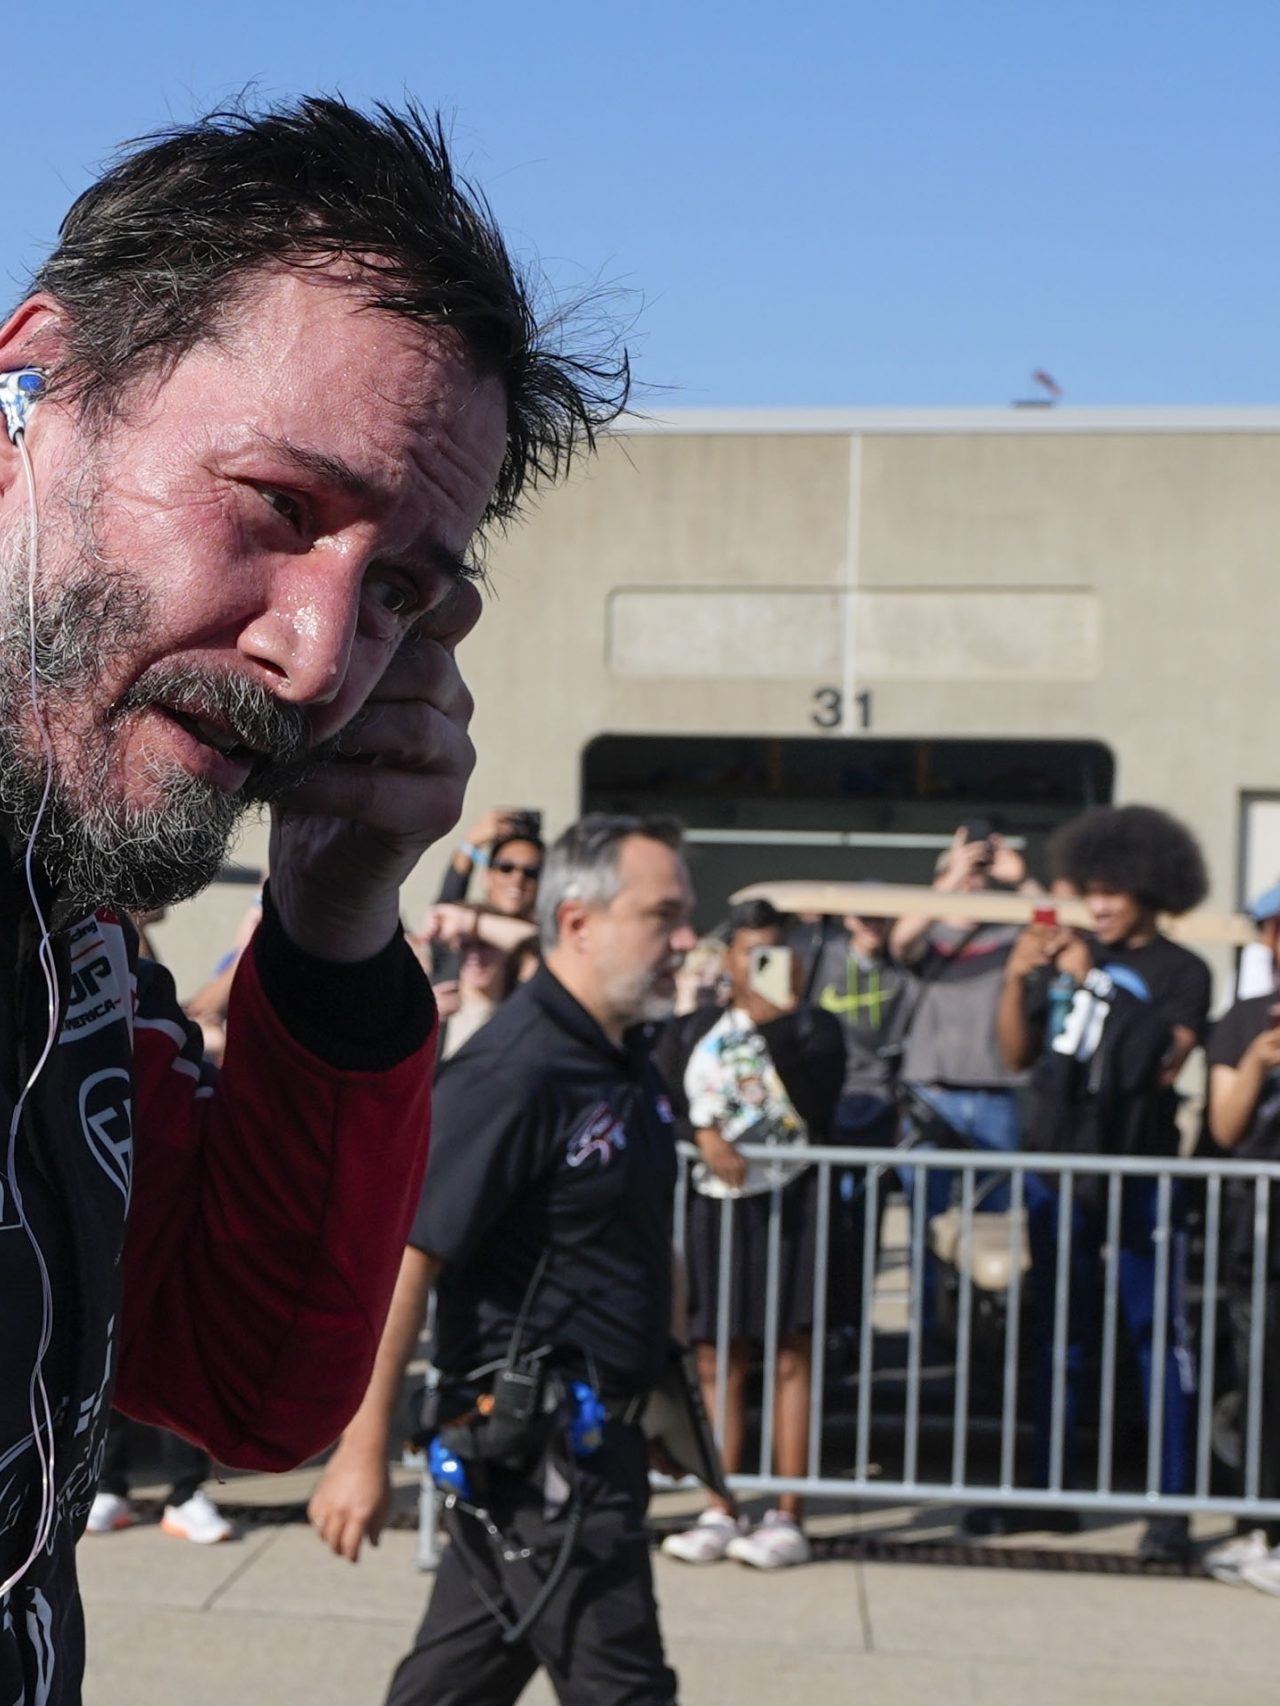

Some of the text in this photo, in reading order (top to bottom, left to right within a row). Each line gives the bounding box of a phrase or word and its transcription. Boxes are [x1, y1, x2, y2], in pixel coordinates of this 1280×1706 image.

[812, 687, 870, 728] 31
[68, 955, 112, 1006] UP
[61, 999, 116, 1032] MERICA
